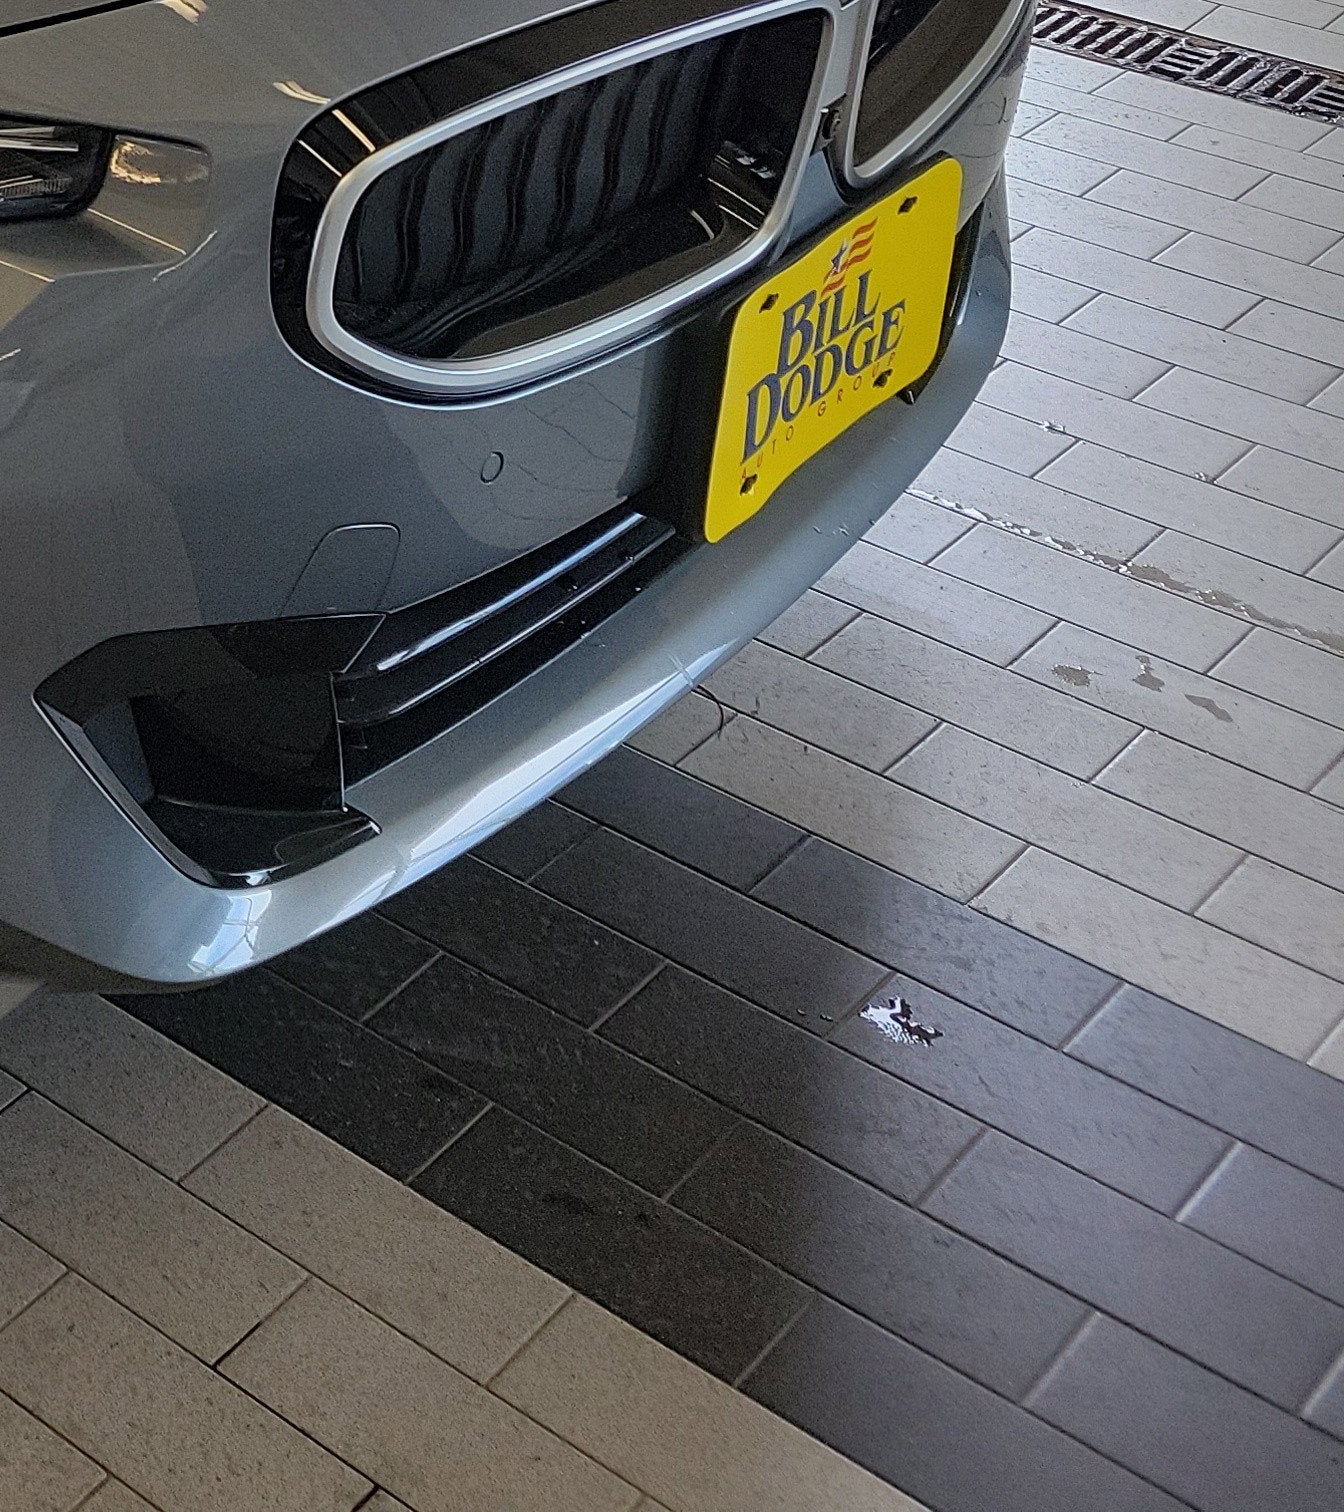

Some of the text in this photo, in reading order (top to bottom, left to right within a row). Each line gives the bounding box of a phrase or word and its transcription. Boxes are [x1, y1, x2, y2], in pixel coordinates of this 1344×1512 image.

[740, 299, 906, 465] DODGE
[776, 269, 882, 375] BILL
[740, 351, 897, 480] AUTO GROUP
